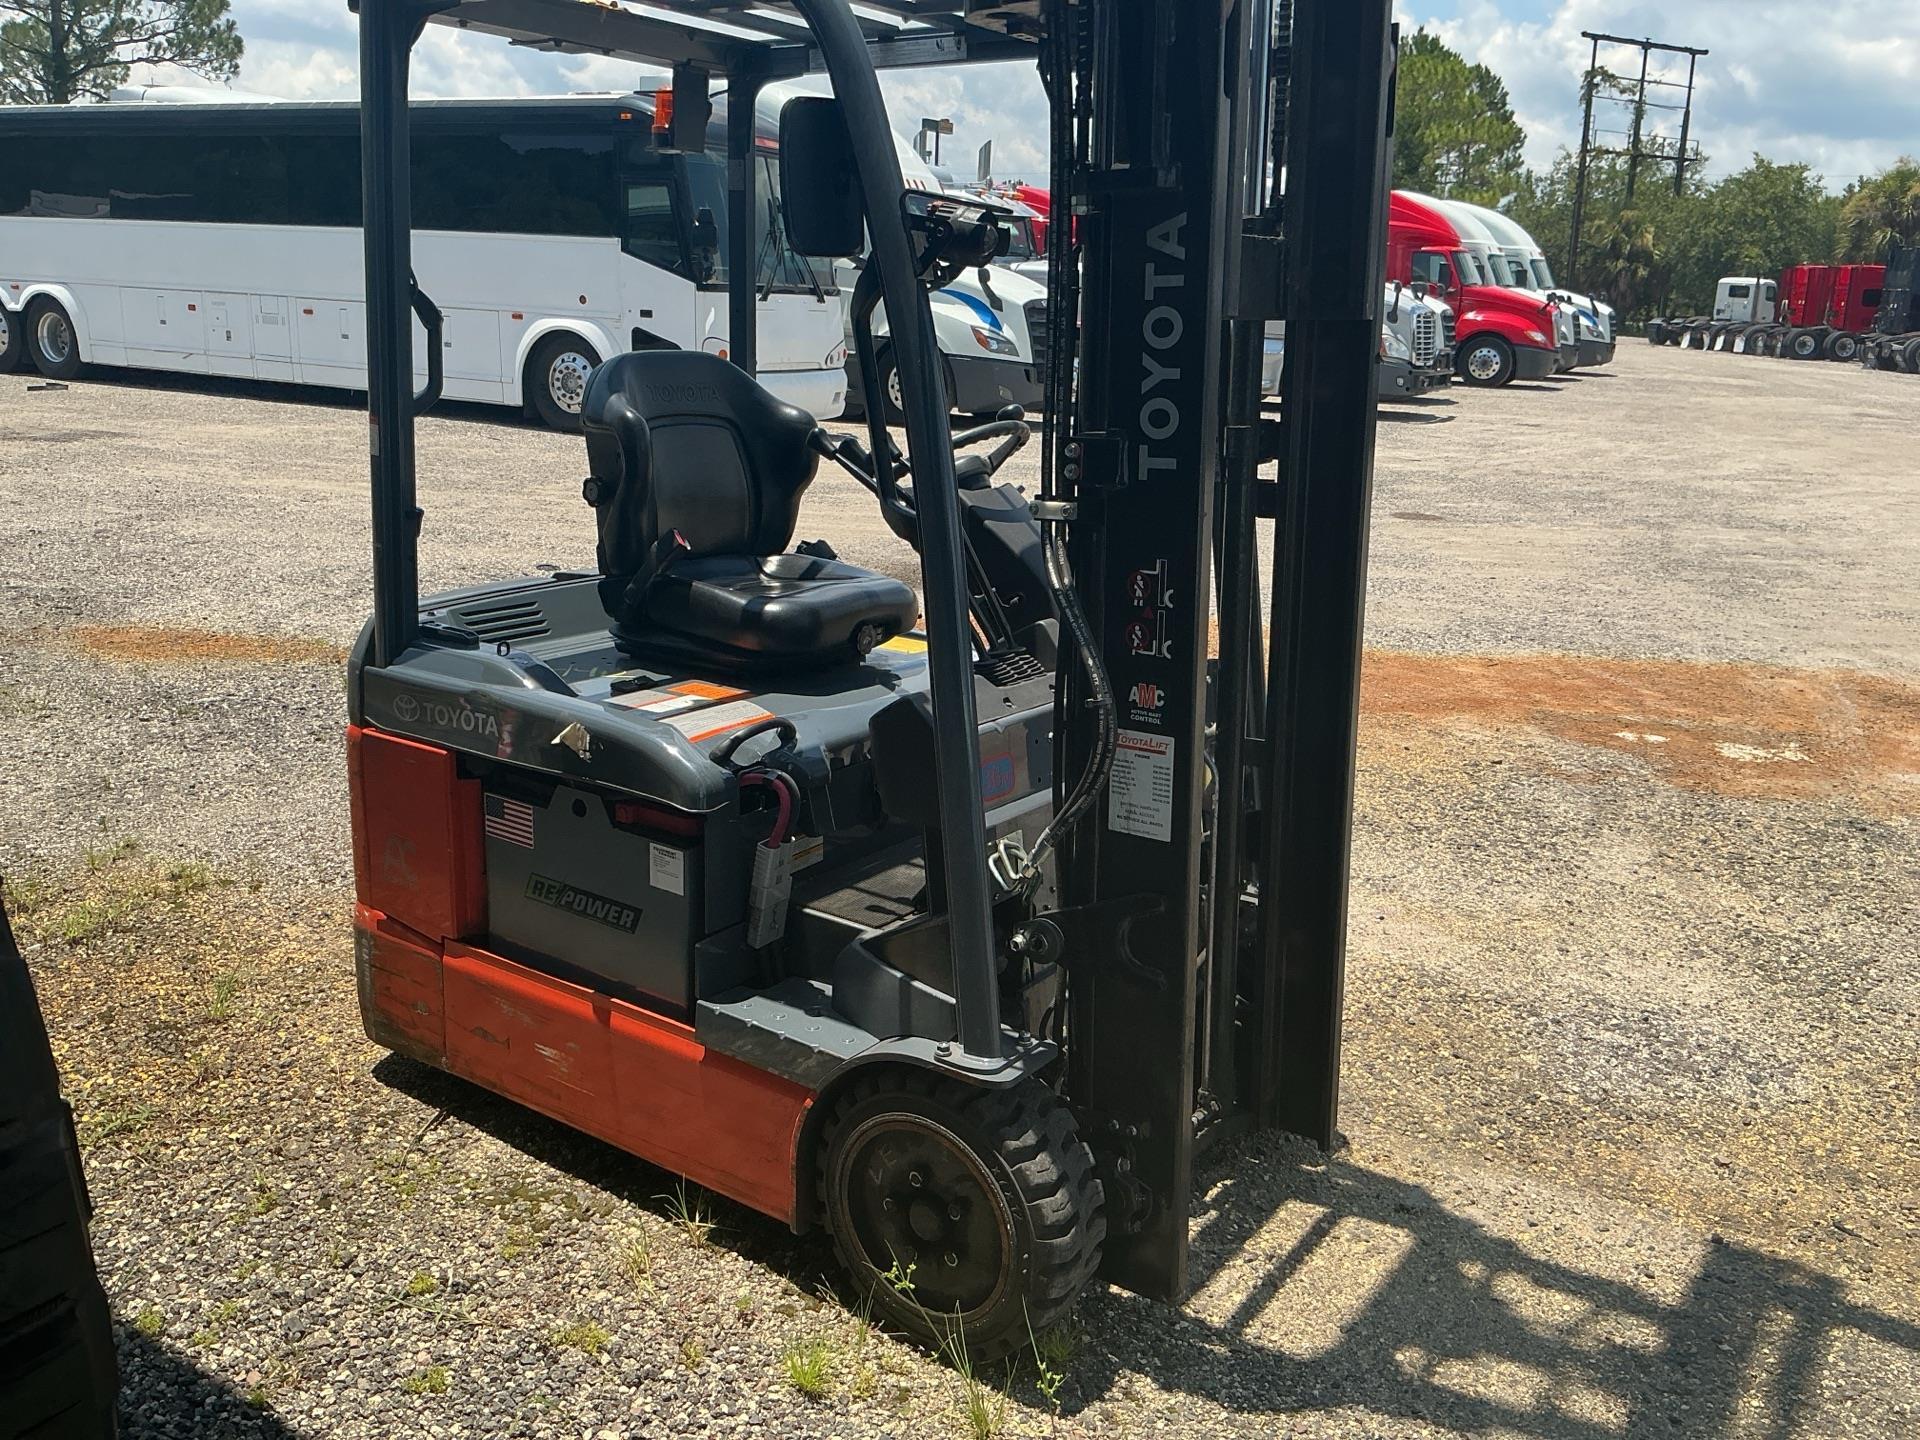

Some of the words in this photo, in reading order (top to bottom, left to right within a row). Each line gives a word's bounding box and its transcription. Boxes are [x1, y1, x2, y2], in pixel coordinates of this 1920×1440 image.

[1138, 212, 1187, 480] TOYOTA
[647, 384, 720, 401] TOYOTA
[1129, 683, 1164, 710] AMC
[424, 704, 499, 737] TOYOTA
[1130, 714, 1162, 725] CONTROL
